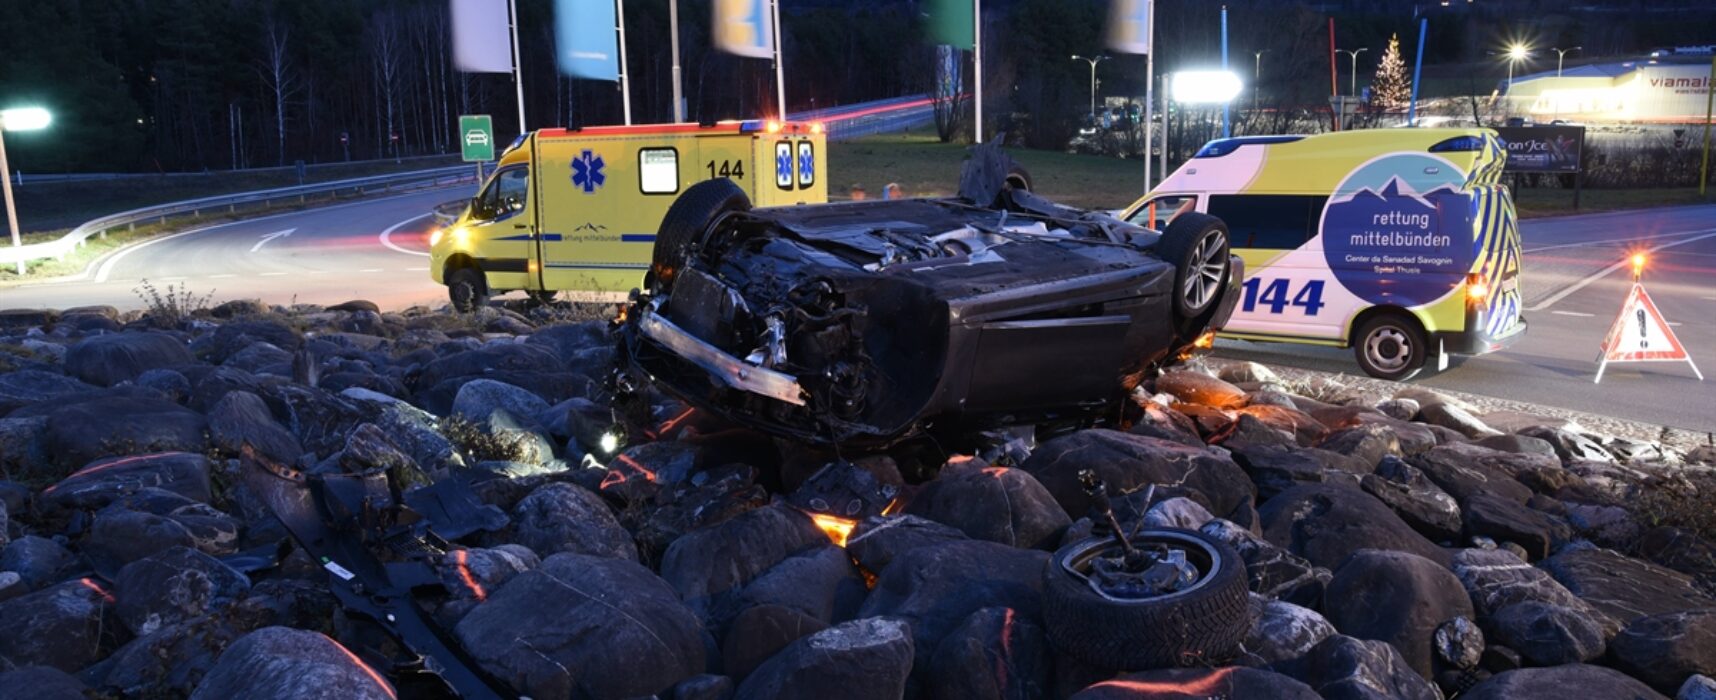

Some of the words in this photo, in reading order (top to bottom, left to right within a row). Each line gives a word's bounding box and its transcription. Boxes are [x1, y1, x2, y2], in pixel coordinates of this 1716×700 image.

[1508, 142, 1524, 151] on
[1525, 139, 1549, 153] Ice
[706, 159, 744, 179] 144
[1373, 211, 1429, 229] rettung
[1350, 232, 1451, 247] mittelbünden
[1345, 254, 1370, 263] Center
[1382, 255, 1416, 264] Sanadad
[1417, 255, 1453, 266] Savognin
[1242, 277, 1326, 316] 144
